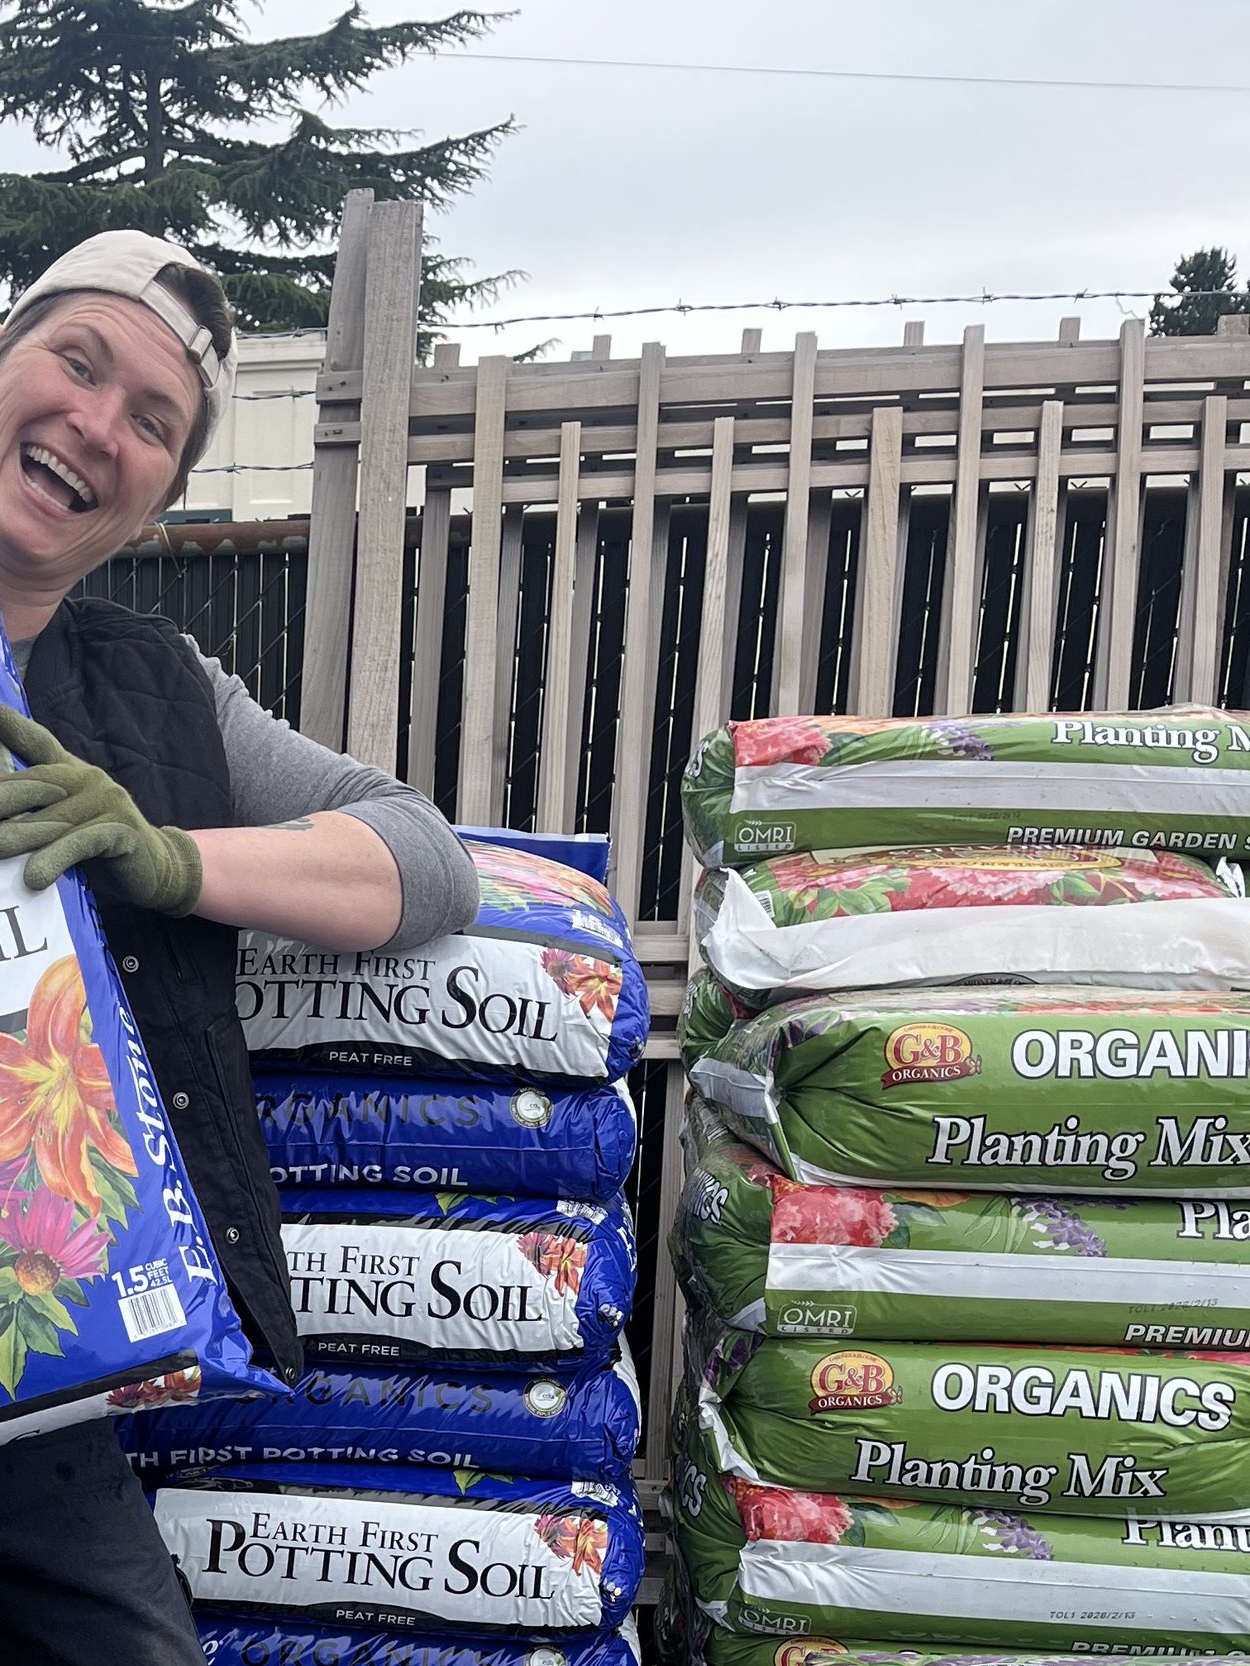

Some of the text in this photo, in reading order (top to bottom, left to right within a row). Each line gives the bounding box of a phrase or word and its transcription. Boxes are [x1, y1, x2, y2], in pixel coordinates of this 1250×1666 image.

[1052, 720, 1221, 766] Planting
[738, 824, 793, 845] OMRI
[1005, 826, 1238, 850] PREMIUM GARDEN
[238, 947, 350, 977] EARTH
[440, 966, 559, 1042] SOIL
[329, 1050, 413, 1067] PEAT FREE
[892, 1032, 962, 1063] G&B
[891, 1064, 962, 1083] ORGANICS
[926, 1114, 1146, 1183] Planting
[392, 1165, 469, 1187] SOIL
[144, 1257, 168, 1272] CUBIC
[147, 1266, 170, 1280] FEET
[339, 1244, 421, 1278] FIRST
[111, 1265, 149, 1298] 1.5
[150, 1274, 173, 1288] 42.5L
[427, 1260, 542, 1323] SOIL
[782, 1305, 853, 1328] OMRI
[318, 1342, 400, 1357] PEAT FREE
[817, 1364, 887, 1396] G&B
[817, 1392, 884, 1409] ORGANICS
[930, 1362, 1237, 1432] ORGANICS
[263, 1445, 411, 1464] POTTING
[409, 1448, 481, 1469] SOIL
[849, 1437, 1172, 1507] Planting Mix
[249, 1512, 440, 1554] EARTH FIRST
[201, 1517, 556, 1601] POTTING SOIL
[335, 1609, 416, 1627] PEAT FREE
[743, 1607, 809, 1633] OMRI
